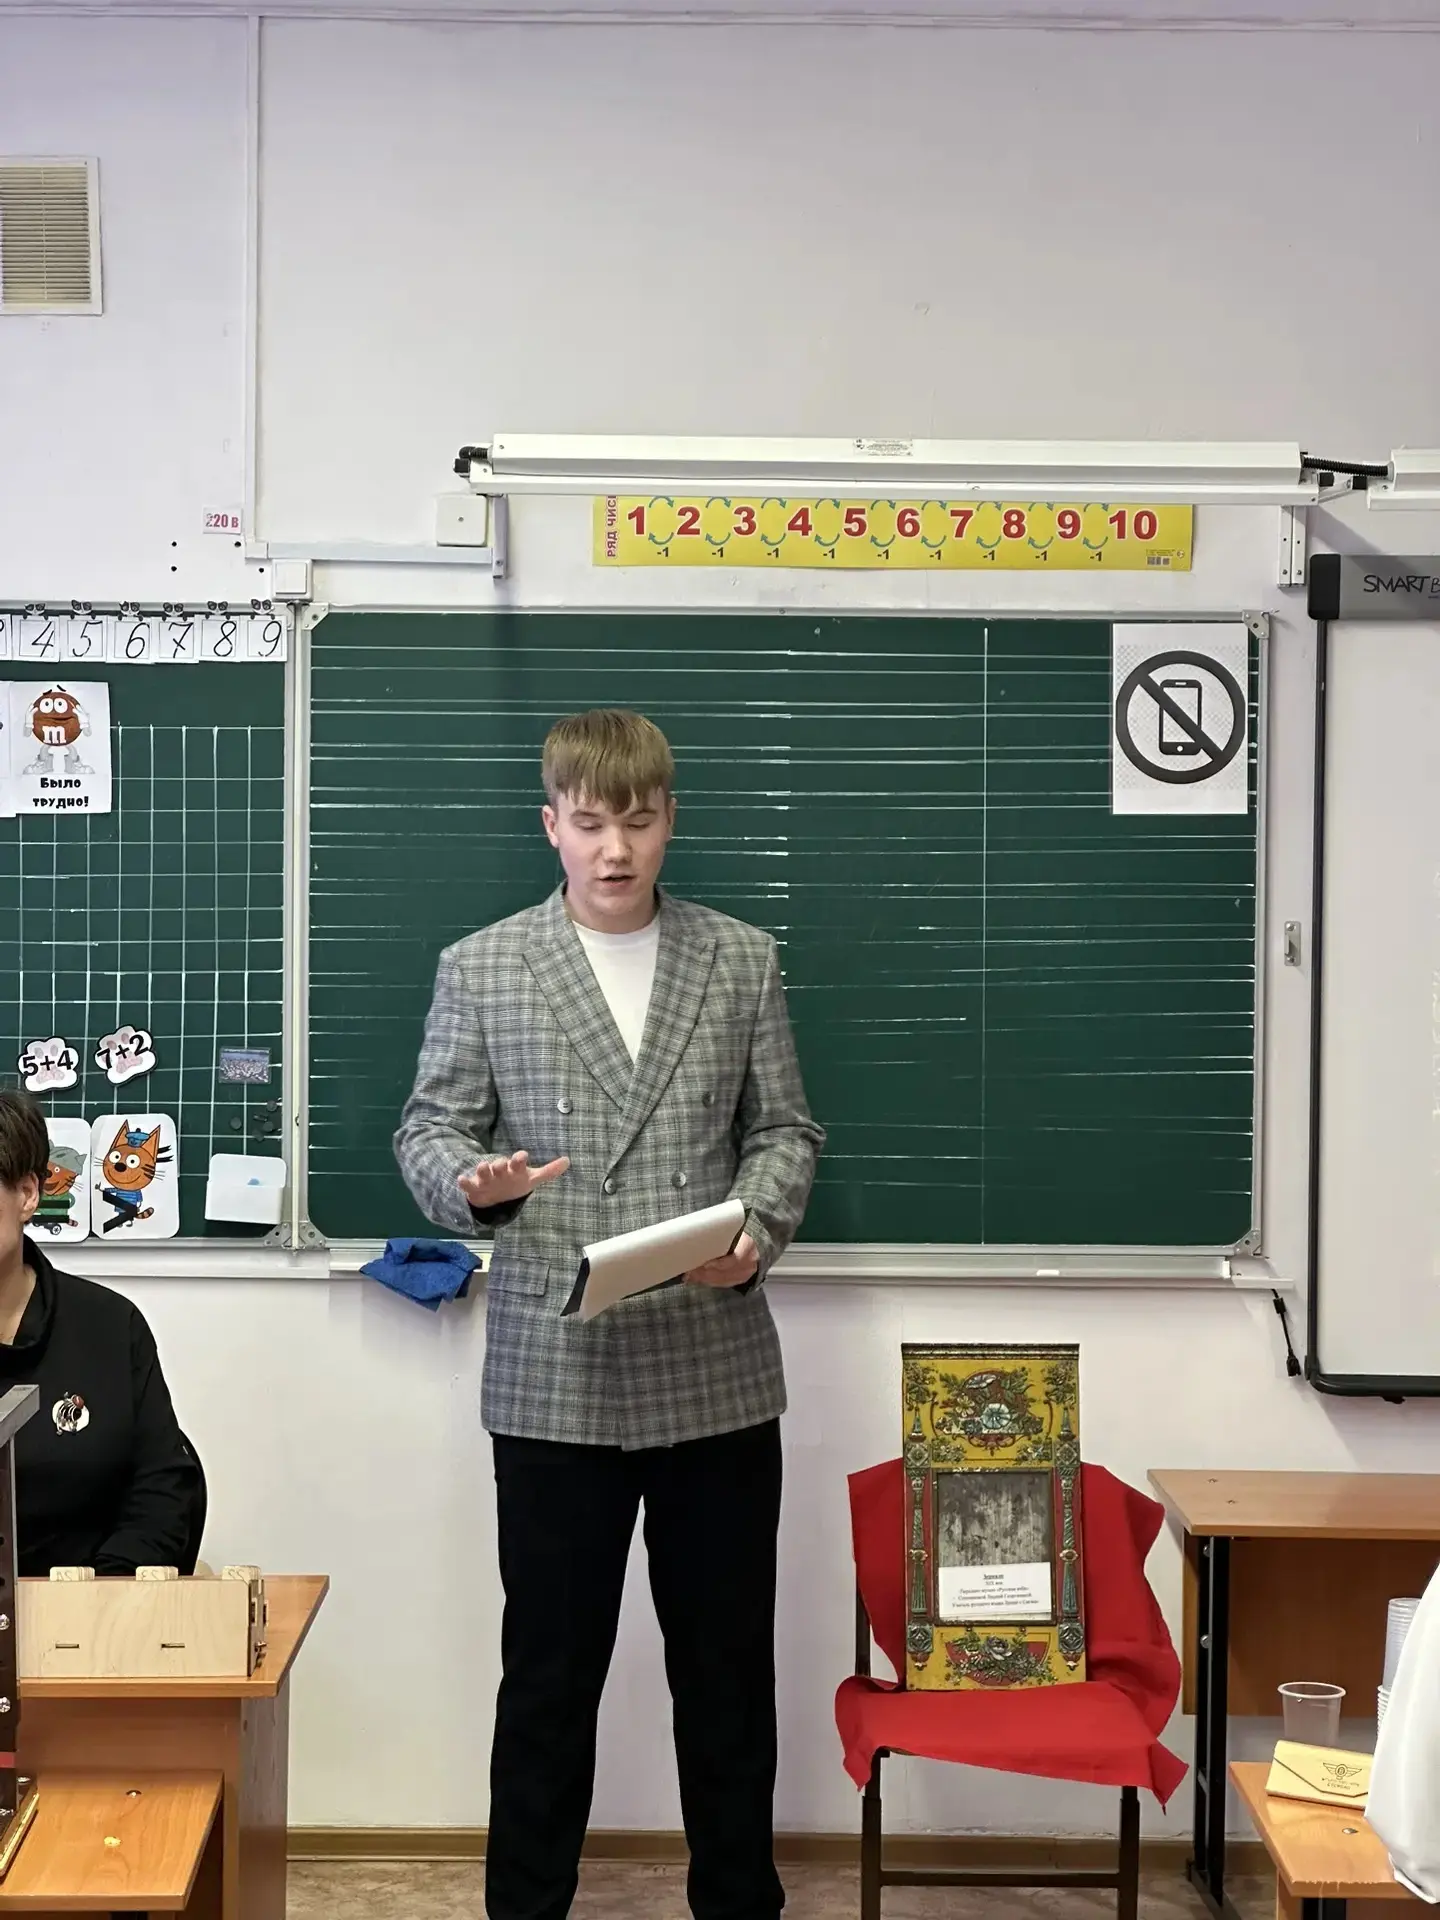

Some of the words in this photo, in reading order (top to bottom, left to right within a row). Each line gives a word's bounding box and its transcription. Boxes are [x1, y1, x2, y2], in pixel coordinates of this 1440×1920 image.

[607, 495, 617, 527] ЧИС
[628, 506, 645, 535] 1
[677, 506, 701, 535] 2
[733, 506, 757, 536] 3
[787, 507, 813, 537] 4
[843, 508, 867, 537] 5
[896, 508, 920, 538] 6
[950, 509, 974, 538] 7
[1002, 509, 1026, 539] 8
[1057, 510, 1081, 539] 9
[1109, 510, 1157, 540] 10
[607, 531, 617, 557] РЯД
[657, 547, 669, 558] -1
[711, 547, 724, 558] -1
[767, 547, 779, 559] -1
[823, 548, 835, 559] -1
[877, 549, 889, 560] -1
[929, 550, 941, 560] -1
[983, 550, 995, 561] -1
[1035, 550, 1048, 561] -1
[1090, 551, 1102, 562] -1
[1363, 574, 1431, 593] SMART
[31, 621, 55, 658] 4
[72, 620, 103, 658] 5
[125, 622, 150, 659] 6
[168, 621, 194, 659] 7
[213, 620, 237, 657] 8
[258, 620, 282, 657] 9
[40, 778, 82, 789] Было
[22, 1050, 74, 1076] 5+4
[97, 1034, 149, 1069] 7+2
